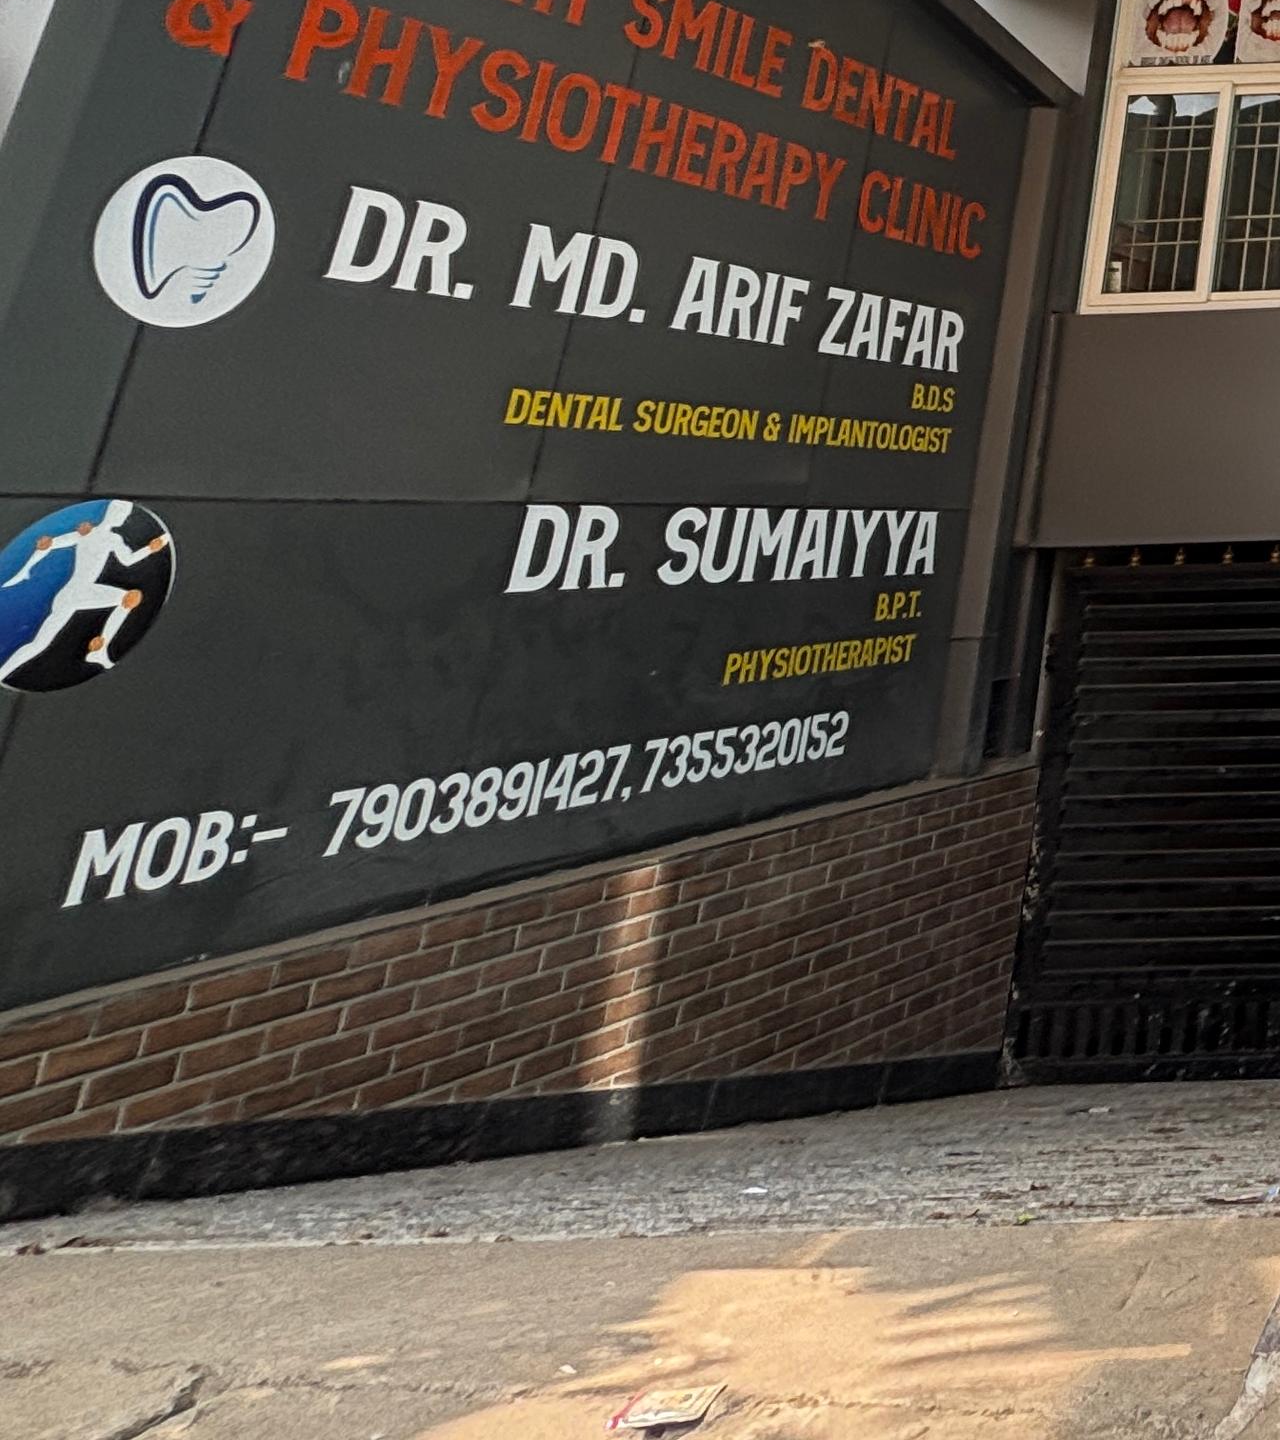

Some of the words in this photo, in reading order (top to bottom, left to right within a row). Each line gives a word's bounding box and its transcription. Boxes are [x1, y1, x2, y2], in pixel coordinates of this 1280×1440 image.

[801, 42, 958, 160] DENTAL
[857, 170, 987, 260] CLINIC
[323, 184, 477, 302] DR.
[509, 222, 646, 323] MD.
[669, 257, 810, 346] ARIF
[817, 287, 964, 373] ZAFAR
[504, 388, 624, 432] DENTAL
[632, 400, 760, 441] SURGEON
[763, 412, 782, 442] &
[788, 414, 952, 454] IMPLANTOLOGIST
[911, 383, 956, 413] B.D.S
[503, 504, 625, 594] DR.
[657, 506, 940, 587] SUMAIYYA
[875, 590, 923, 622] B.P.T.
[722, 633, 918, 687] PHYSIOTHERAPIST
[61, 810, 288, 909] MOB:-
